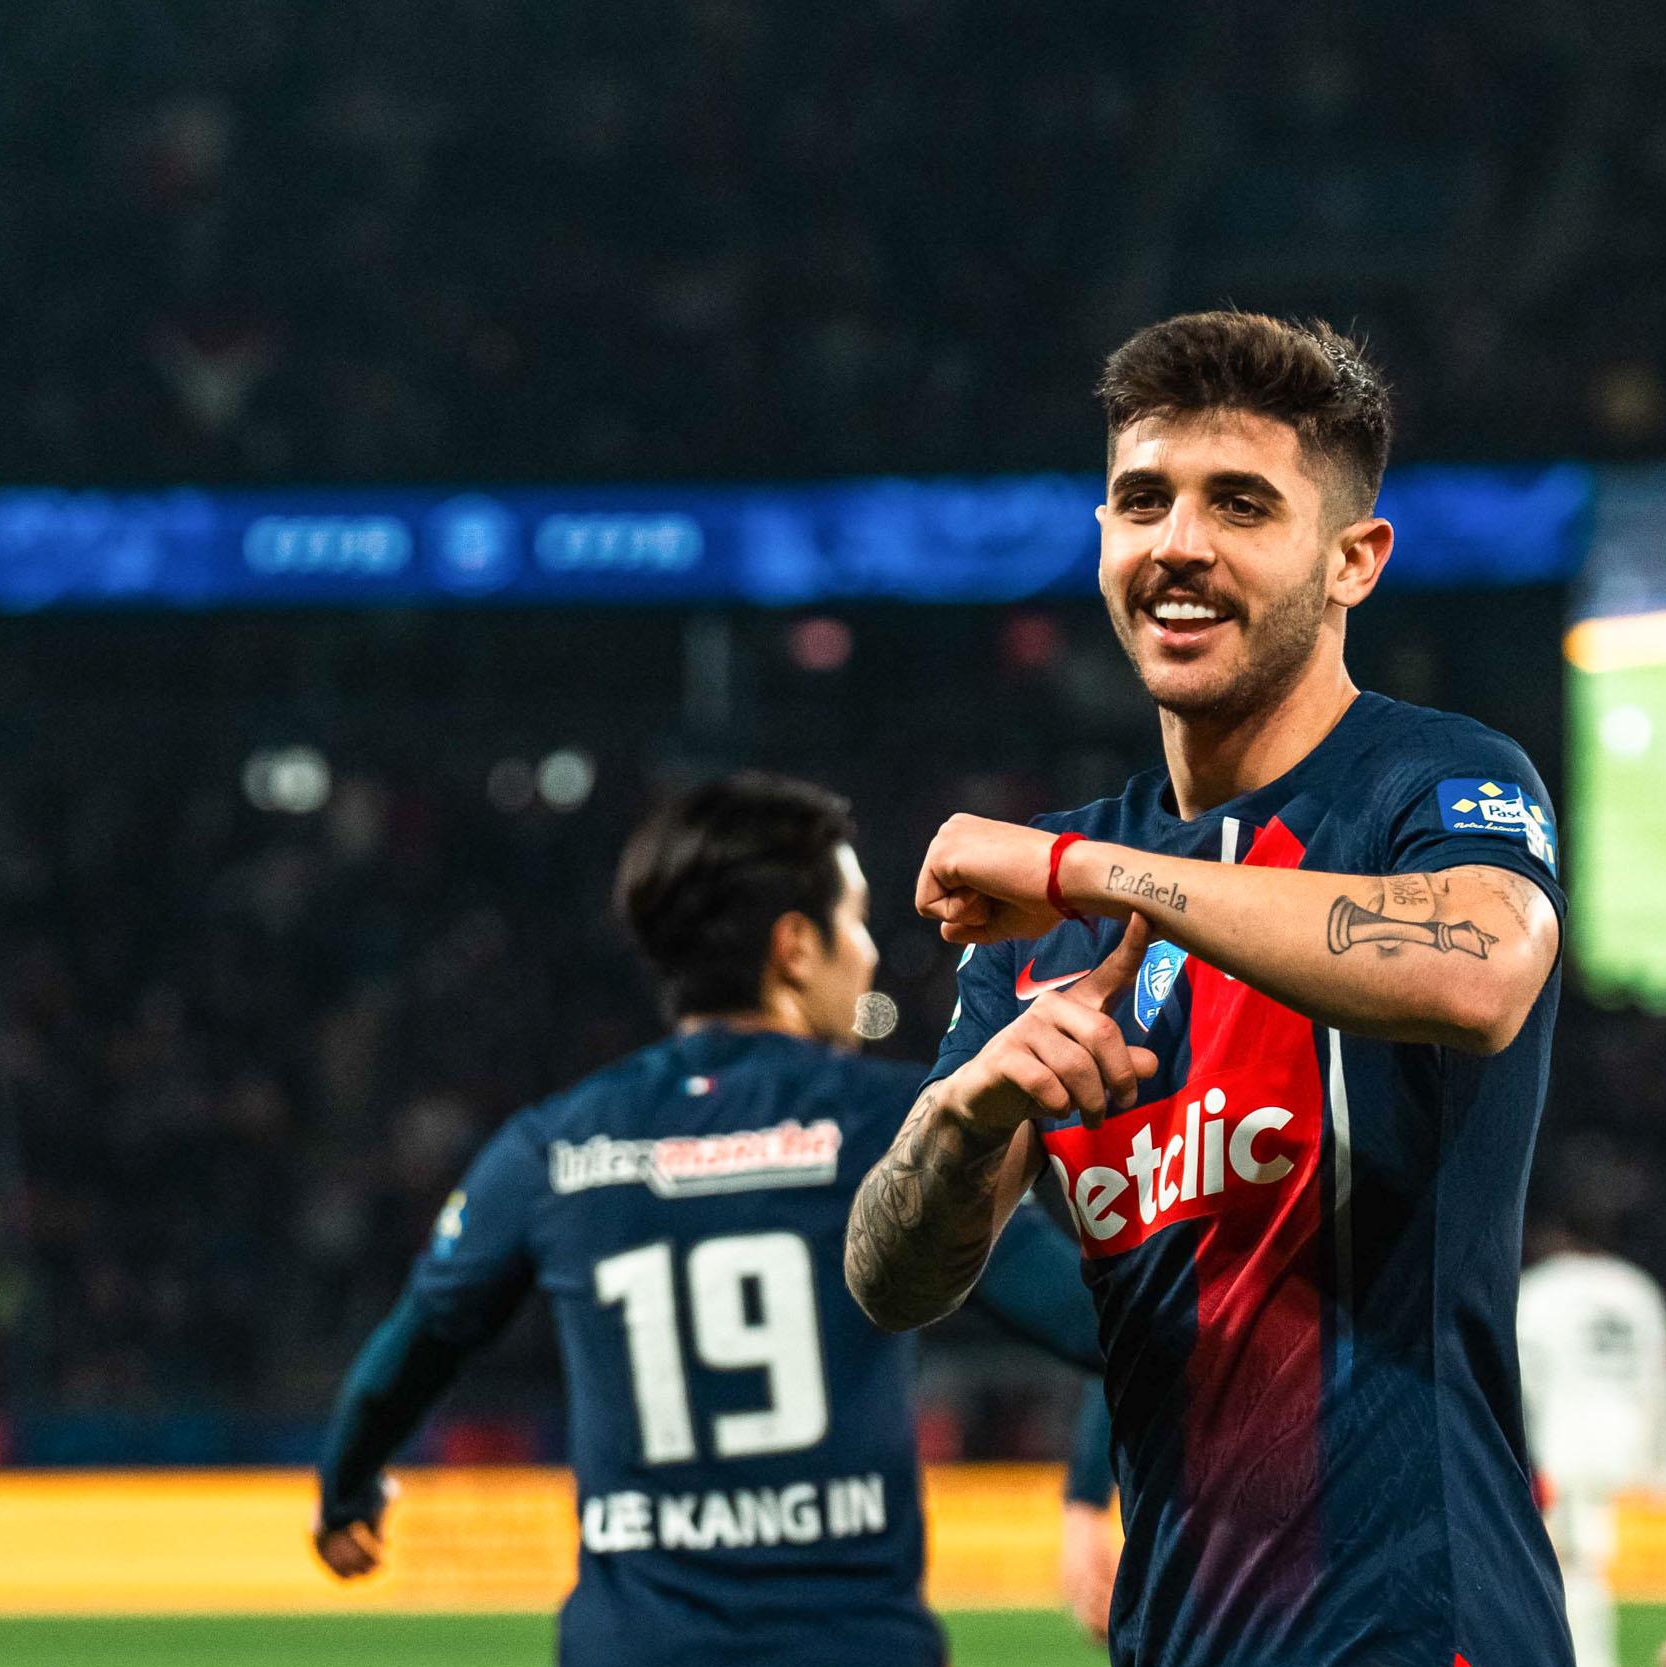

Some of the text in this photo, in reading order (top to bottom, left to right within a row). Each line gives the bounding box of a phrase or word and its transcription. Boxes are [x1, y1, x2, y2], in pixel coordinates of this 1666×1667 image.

[1106, 864, 1188, 914] Rafaela
[1049, 1088, 1294, 1240] etclic
[593, 1230, 829, 1465] 19
